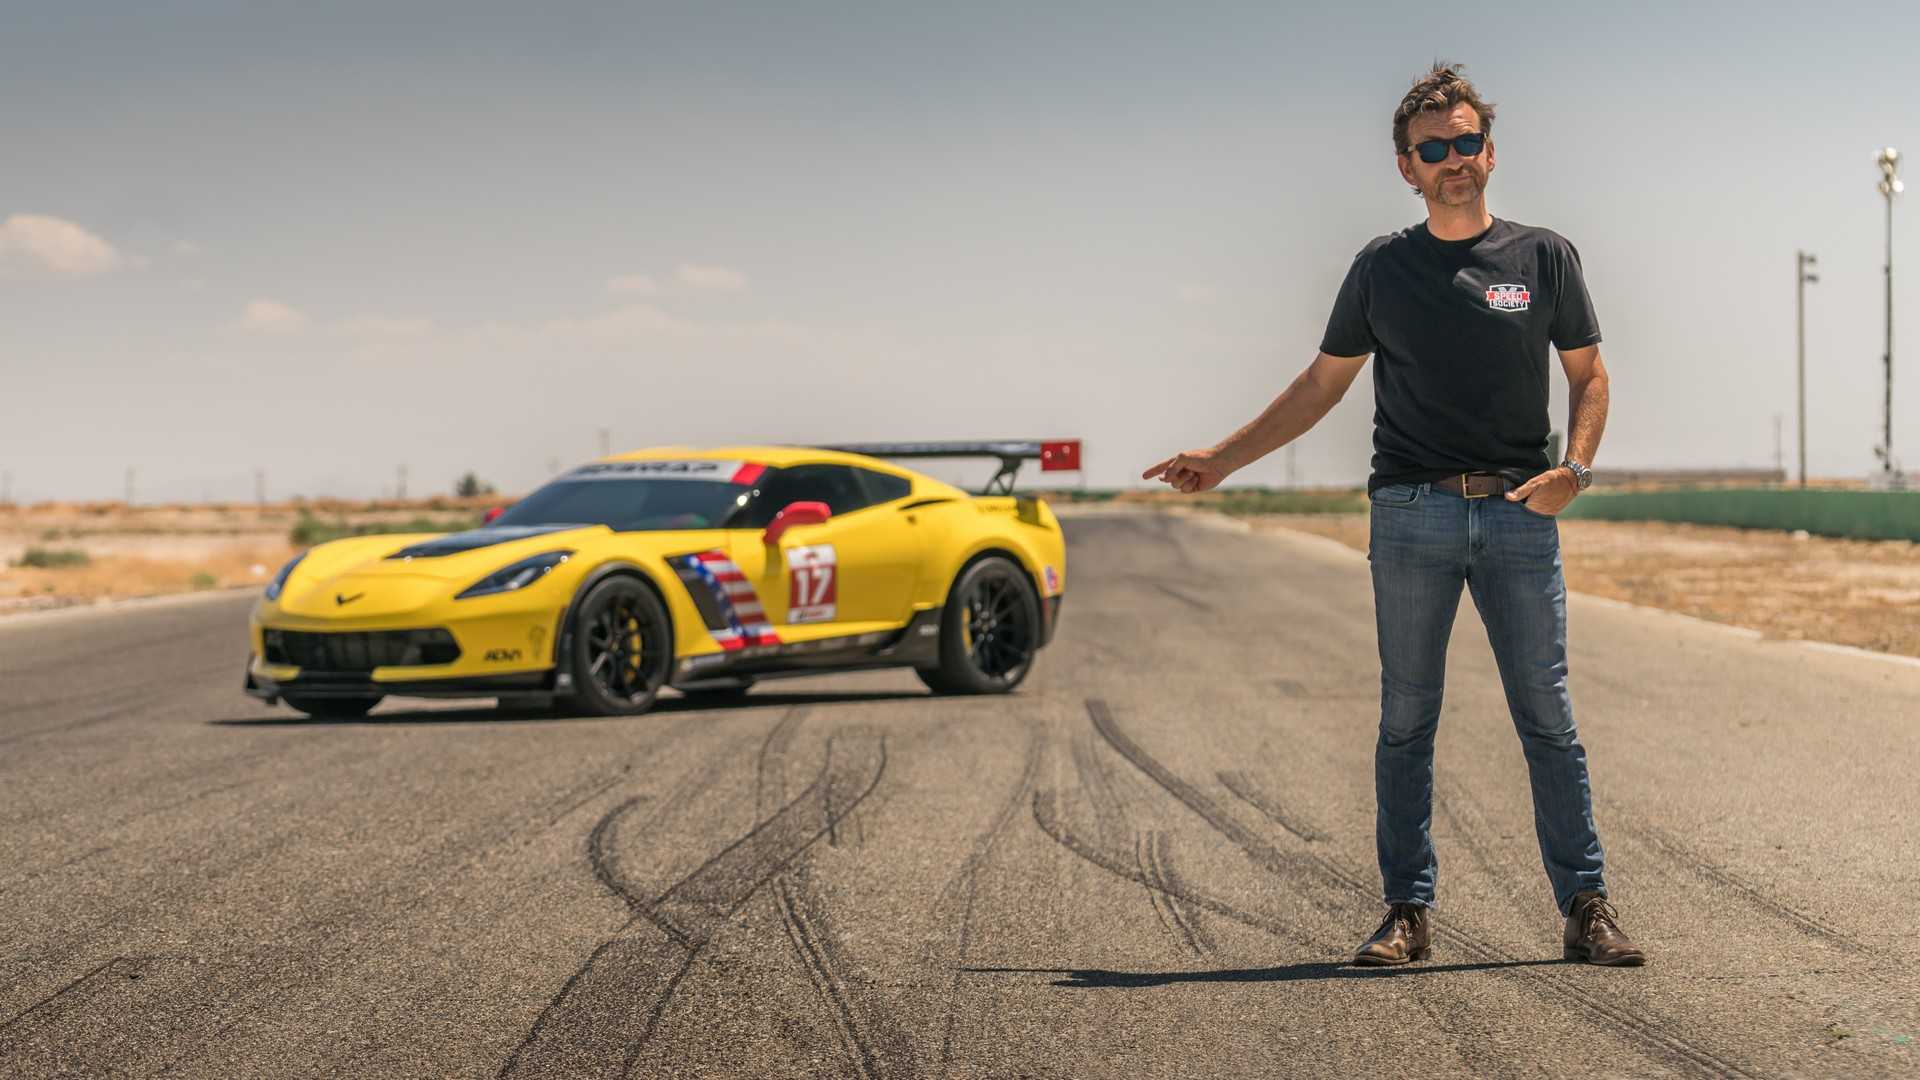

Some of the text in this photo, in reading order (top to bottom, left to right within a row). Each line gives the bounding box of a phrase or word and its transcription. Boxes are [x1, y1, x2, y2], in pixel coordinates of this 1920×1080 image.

[1494, 291, 1523, 301] SPEED
[1492, 300, 1525, 308] SOCIETY
[796, 566, 832, 605] 17
